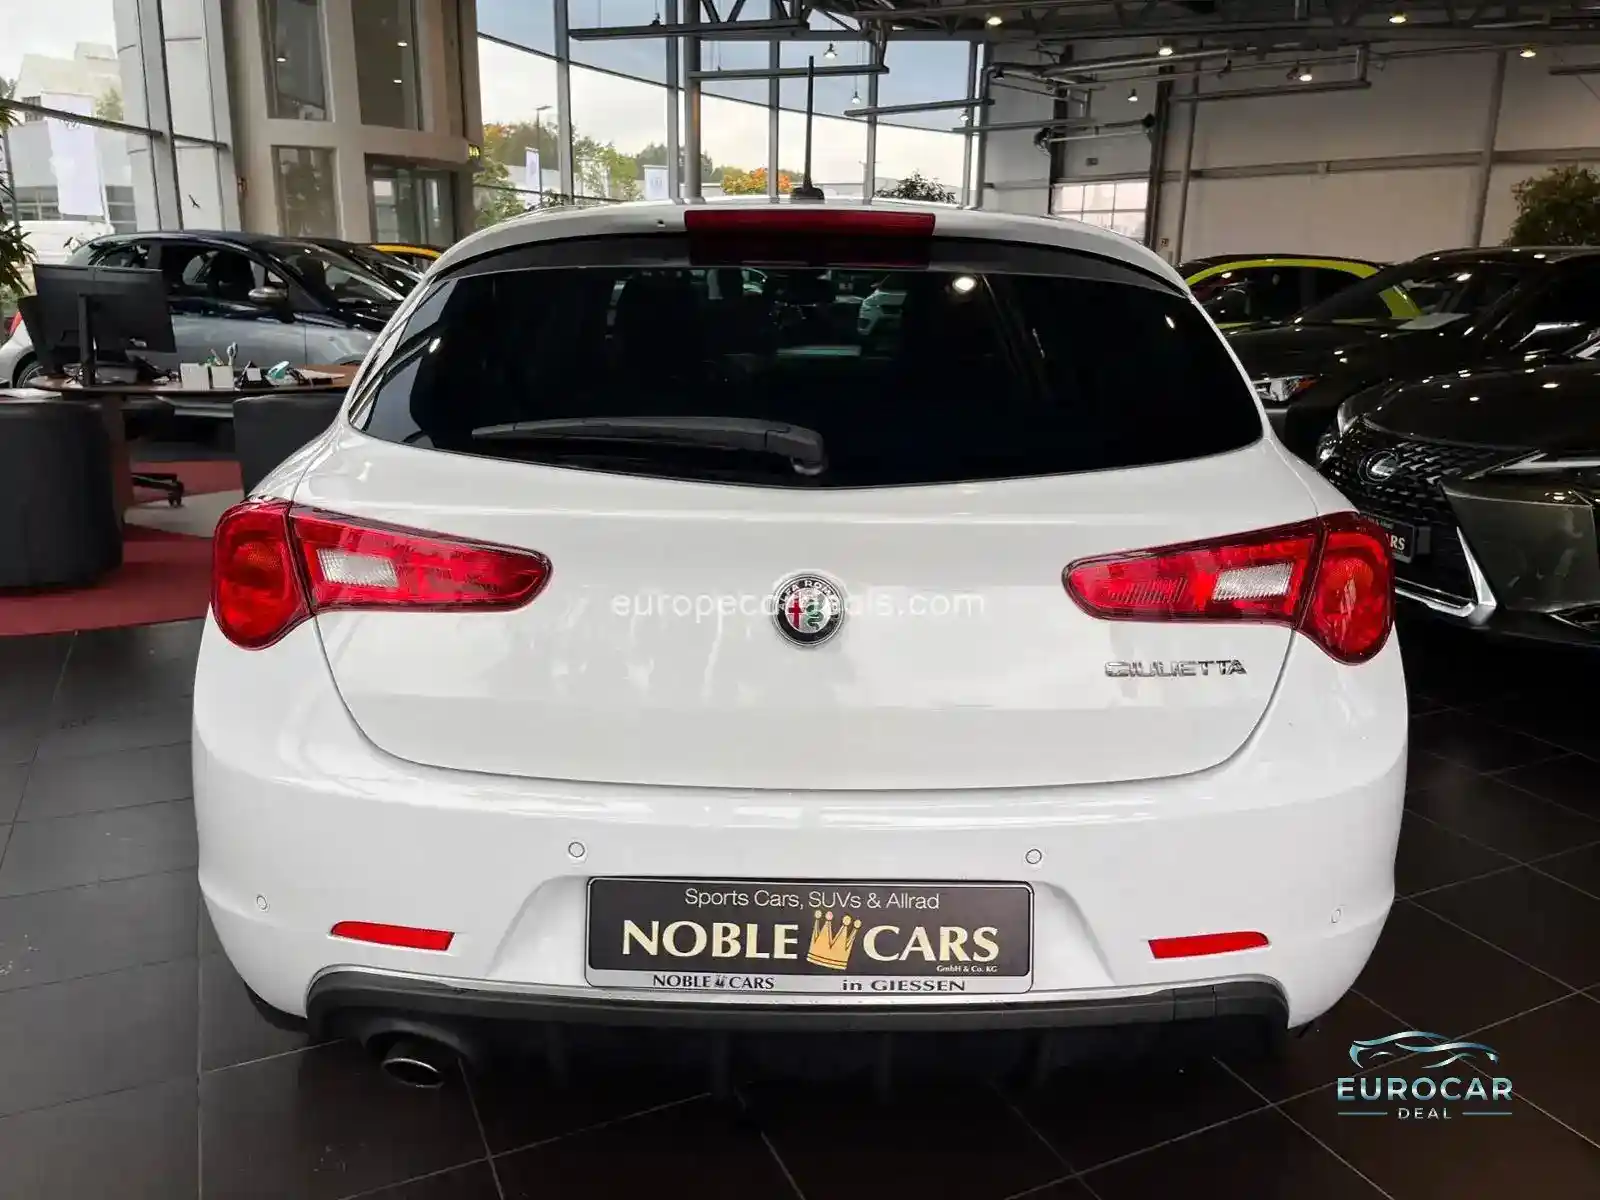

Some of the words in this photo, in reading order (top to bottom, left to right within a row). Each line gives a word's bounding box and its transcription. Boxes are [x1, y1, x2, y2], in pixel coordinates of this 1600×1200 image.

[1104, 659, 1248, 678] GIULIETTA
[685, 888, 749, 908] Sports
[754, 890, 804, 910] Cars,
[808, 891, 861, 909] SUVs
[866, 893, 882, 909] &
[886, 893, 940, 909] Allrad
[622, 919, 799, 960] NOBLE
[862, 925, 1000, 963] CARS
[936, 964, 961, 973] GmbH
[653, 974, 711, 988] NOBLE
[729, 976, 775, 990] CARS
[842, 979, 860, 992] in
[871, 980, 965, 992] GIESSEN
